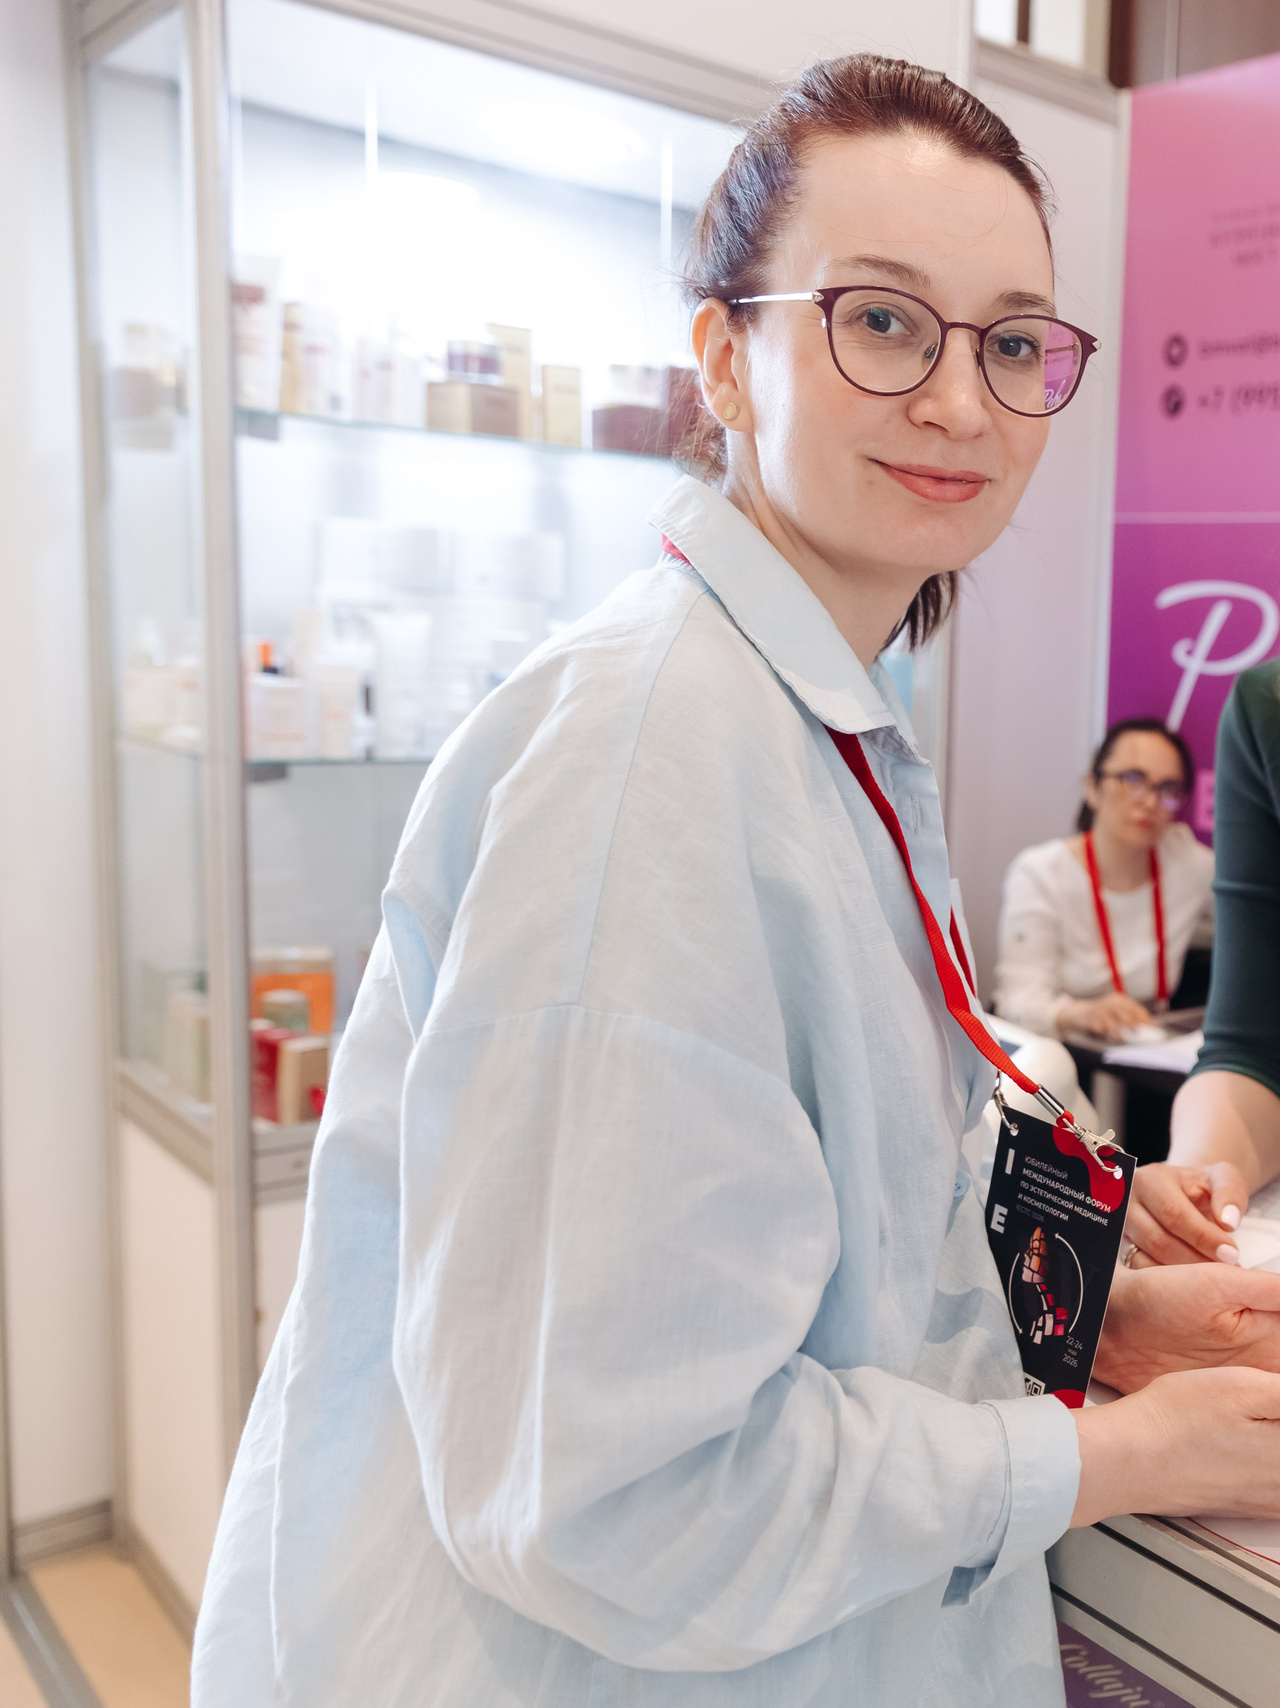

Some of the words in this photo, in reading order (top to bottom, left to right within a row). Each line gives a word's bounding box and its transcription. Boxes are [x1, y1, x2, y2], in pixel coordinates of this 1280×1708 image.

[1025, 1155, 1068, 1180] ЮБИЛЕЙНЫЙ
[1020, 1180, 1029, 1189] ПО
[1029, 1184, 1073, 1210] ЭСТЕТИЧЕСКОЙ
[1074, 1205, 1109, 1227] МЕДИЦИНЕ
[1023, 1168, 1085, 1200] МЕЖДУНАРОДНЫЙ
[1085, 1196, 1111, 1214] ФОРУМ
[1023, 1196, 1069, 1222] КОСМЕТОЛОГИИ
[1062, 1353, 1078, 1368] 2026
